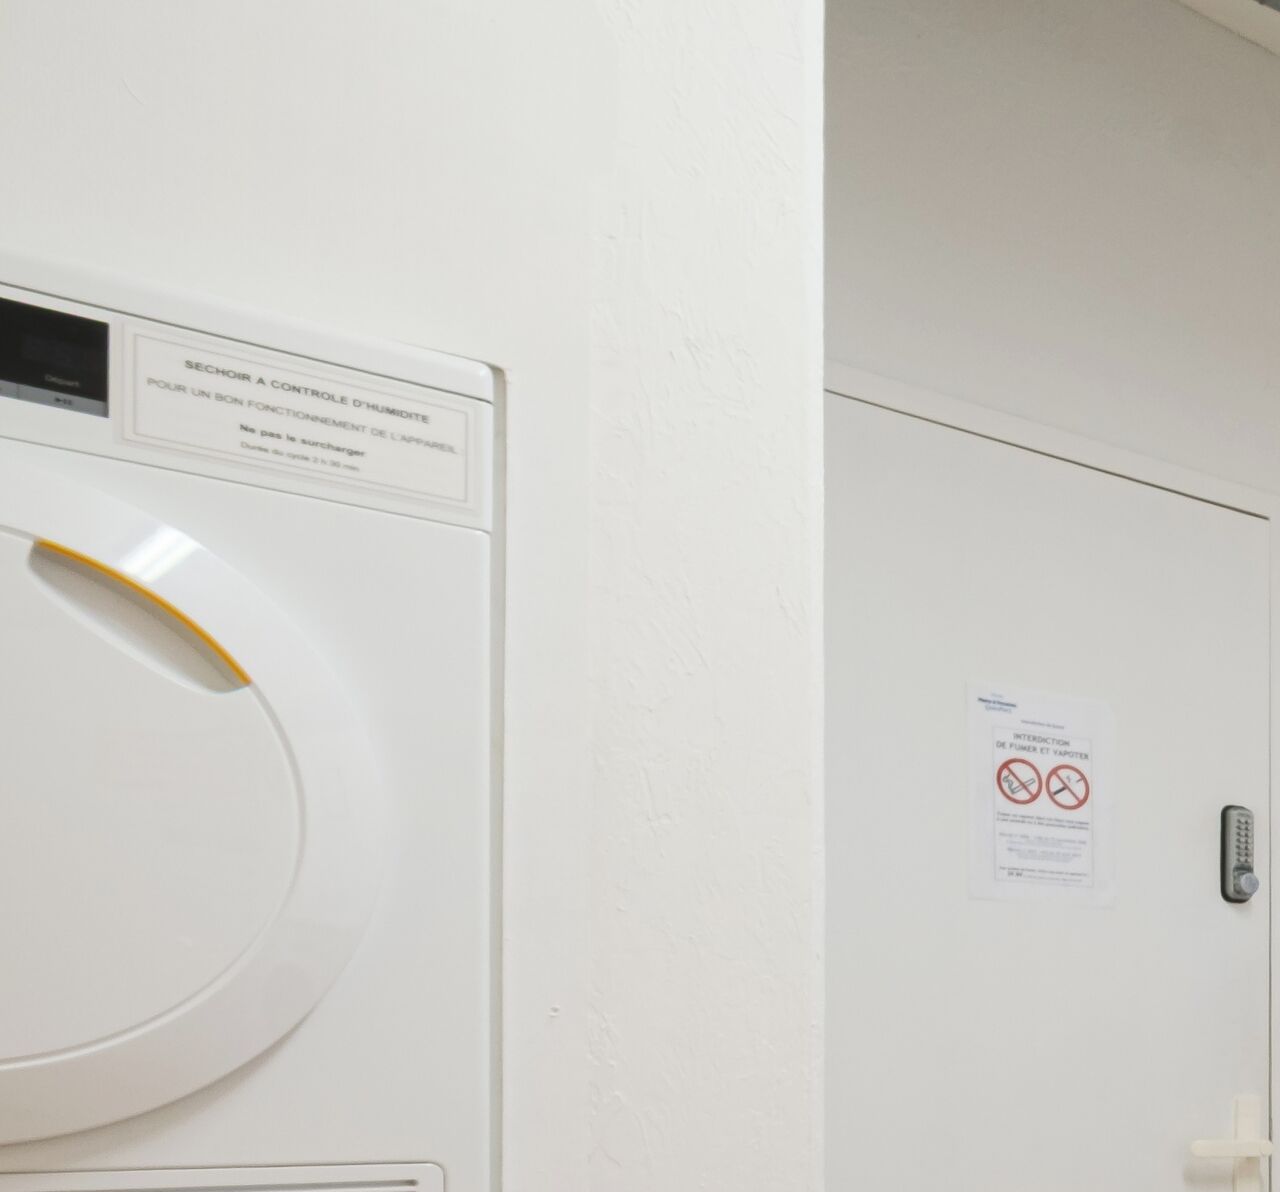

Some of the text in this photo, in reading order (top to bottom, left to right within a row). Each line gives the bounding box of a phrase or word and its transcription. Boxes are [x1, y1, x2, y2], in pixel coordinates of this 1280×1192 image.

[147, 377, 187, 393] POUR
[191, 388, 211, 399] UN
[214, 393, 243, 407] BON
[247, 400, 367, 433] FONCTIONNEMENT
[185, 360, 251, 382] SECHOIR
[256, 377, 266, 386] A
[270, 380, 348, 406] CONTROLE
[240, 424, 256, 434] Ne
[260, 426, 282, 440] pas
[301, 439, 366, 457] surcharger
